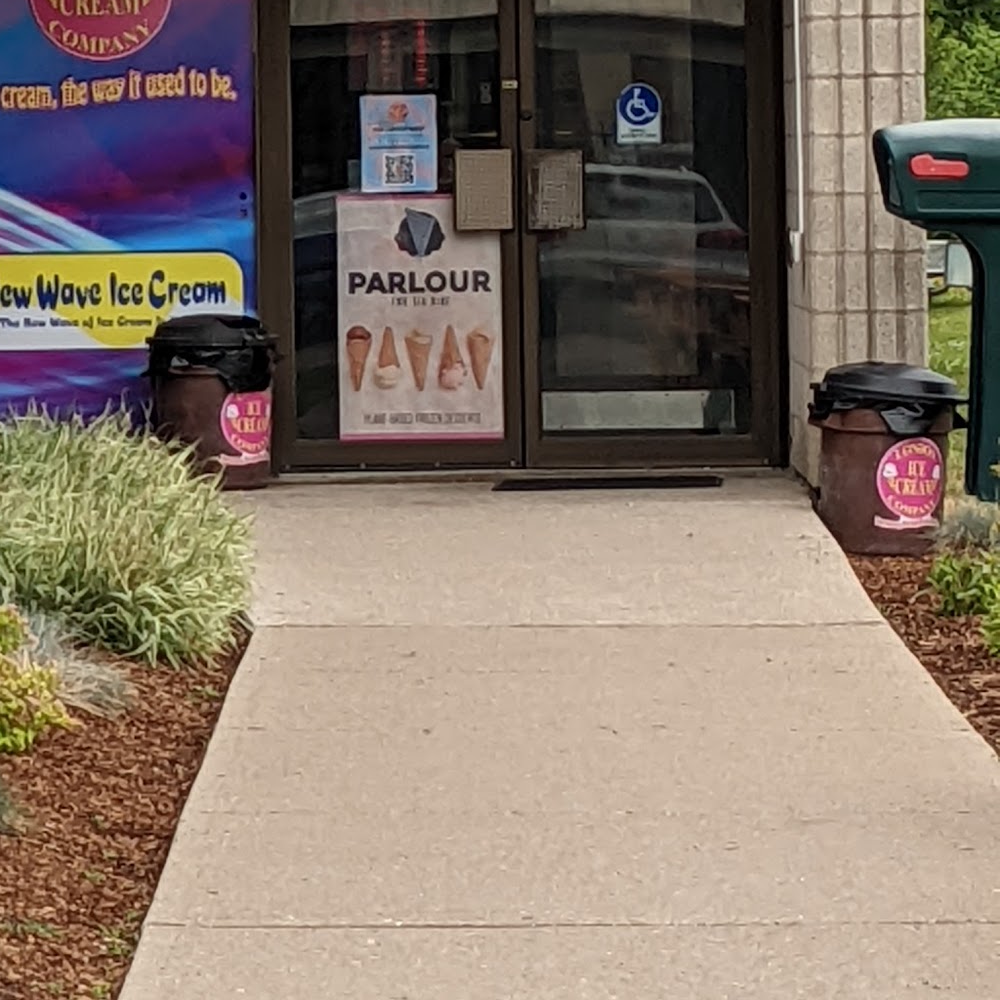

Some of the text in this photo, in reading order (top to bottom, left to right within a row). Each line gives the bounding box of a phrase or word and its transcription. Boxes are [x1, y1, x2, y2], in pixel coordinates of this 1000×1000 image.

[48, 19, 150, 55] COMPANY
[61, 75, 88, 107] the
[92, 77, 126, 102] way
[146, 65, 185, 98] used
[188, 68, 207, 98] to
[211, 66, 238, 100] be.
[36, 272, 101, 310] Wave
[110, 271, 143, 307] Ice
[148, 269, 226, 310] Cream
[348, 270, 491, 294] PARLOUR
[24, 317, 46, 328] New
[50, 317, 79, 328] Wave
[97, 316, 113, 327] Ice
[117, 315, 152, 327] Cream
